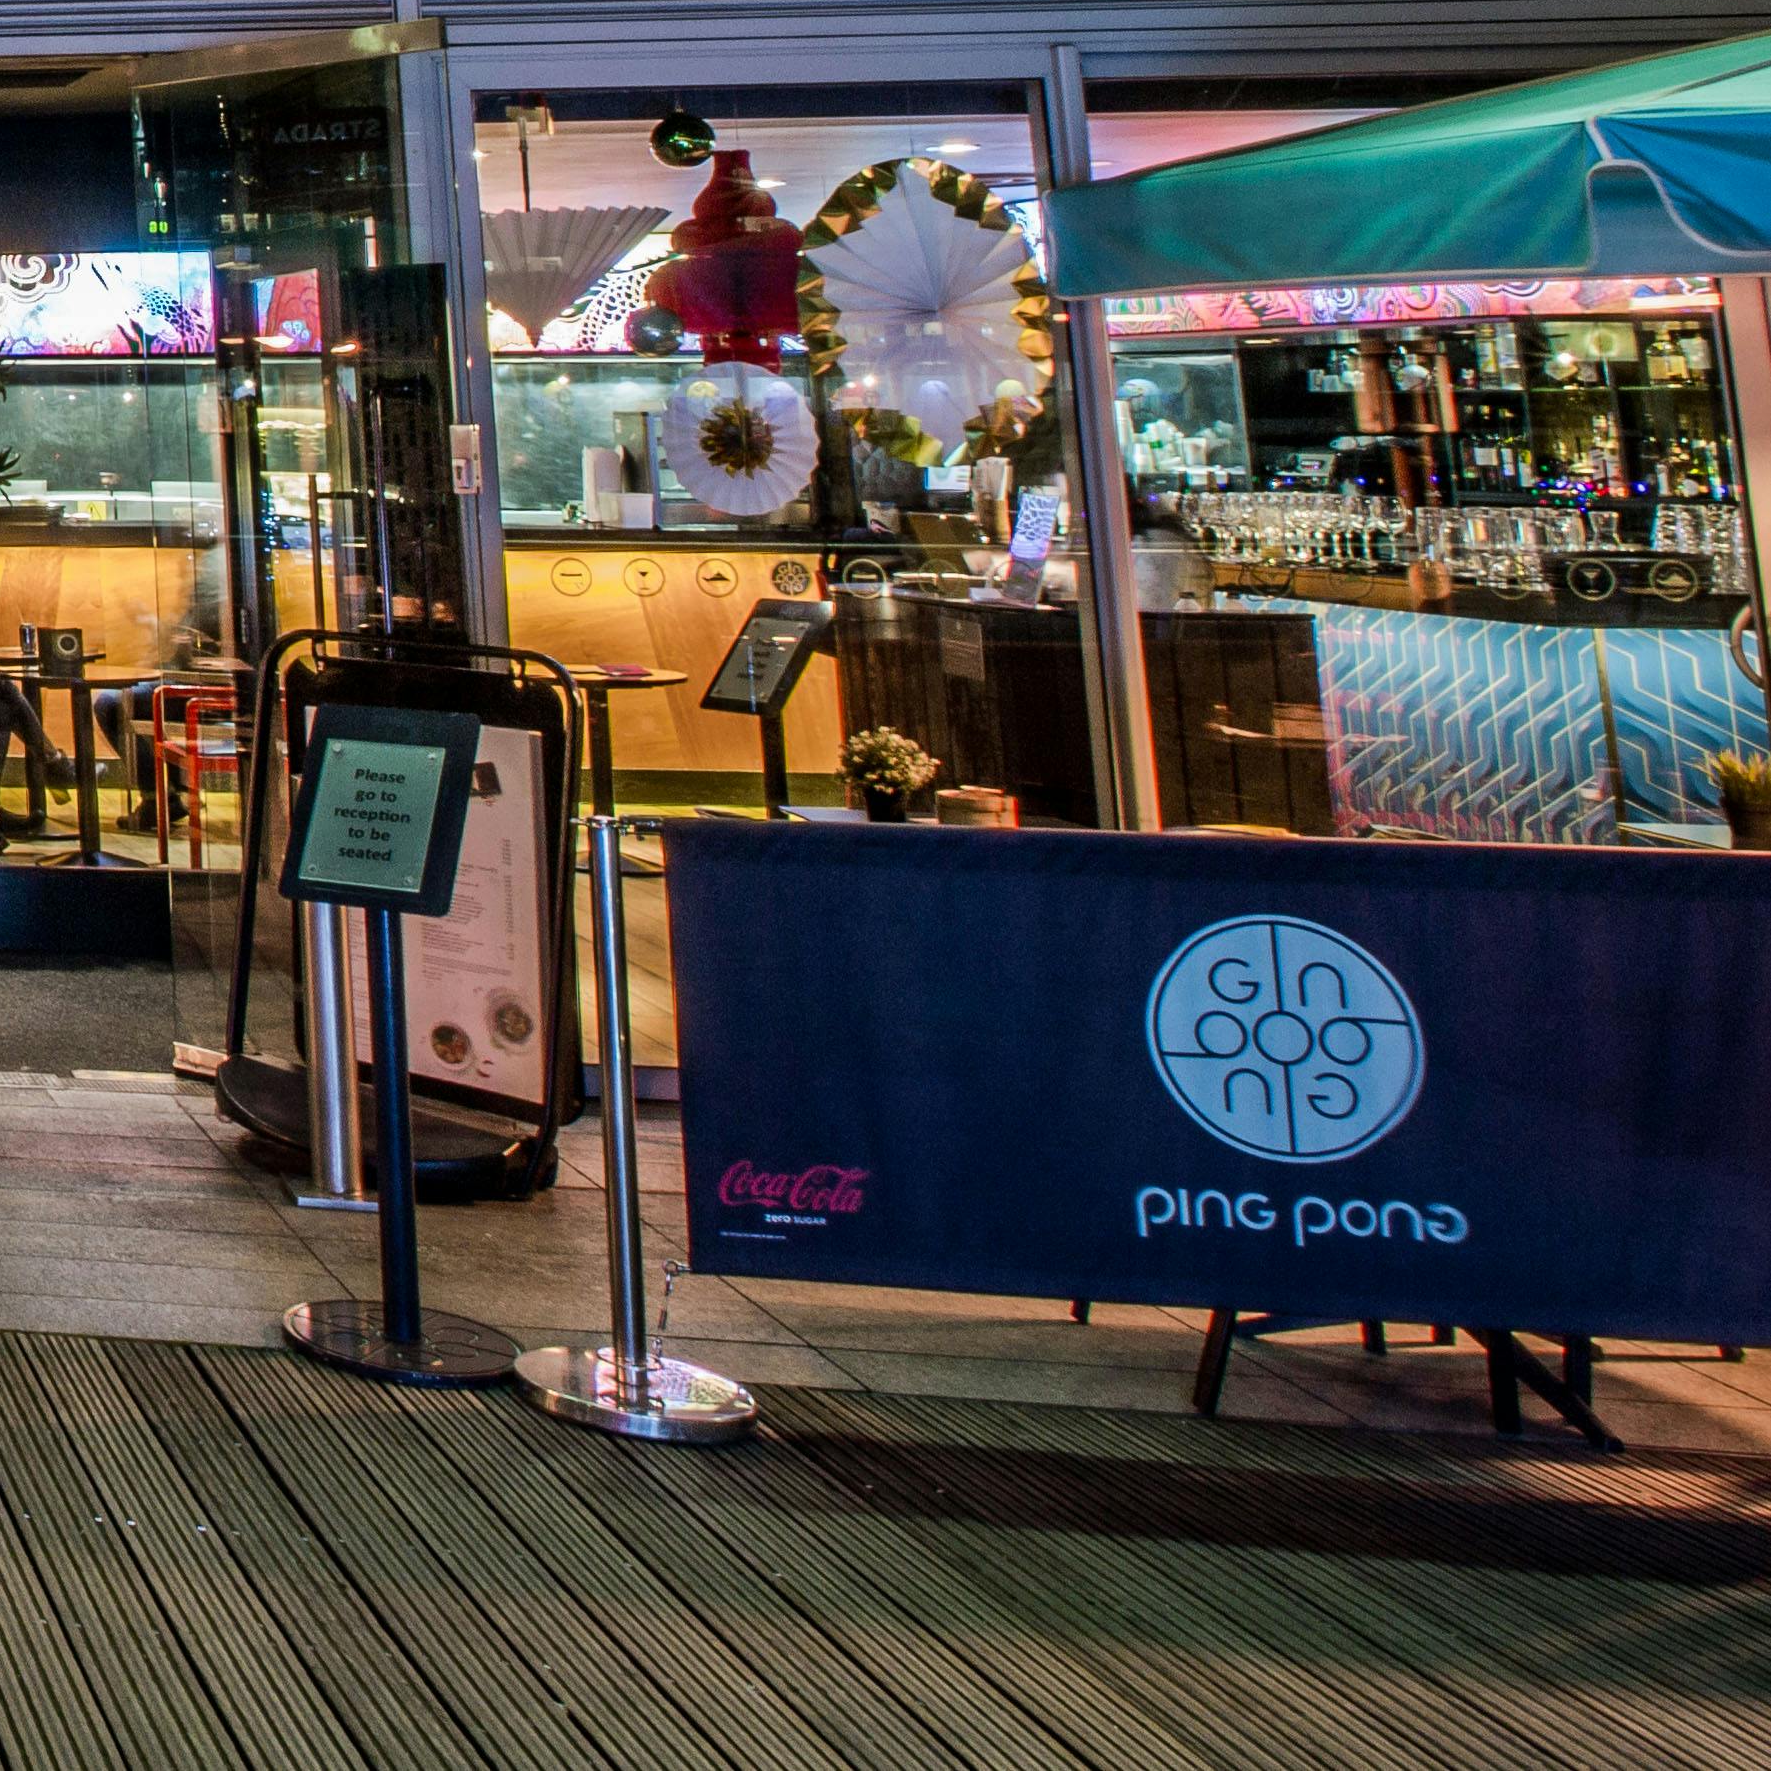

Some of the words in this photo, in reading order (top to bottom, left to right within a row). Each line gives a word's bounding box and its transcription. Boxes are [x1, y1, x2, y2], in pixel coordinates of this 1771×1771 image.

[354, 768, 406, 784] Please
[354, 790, 375, 802] go
[380, 791, 397, 803] to
[334, 806, 411, 823] reception
[348, 827, 364, 839] to
[370, 828, 391, 841] be
[338, 847, 392, 861] seated
[719, 1160, 872, 1213] Coca-Cola
